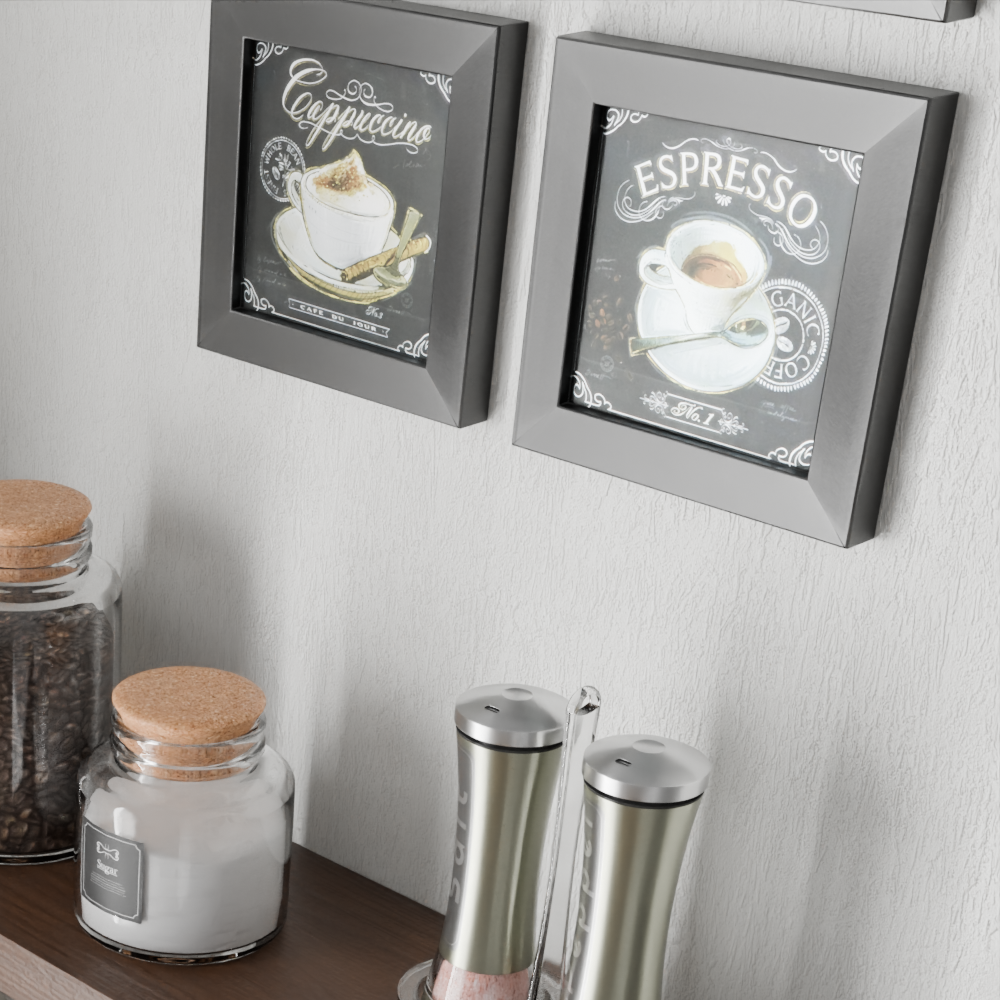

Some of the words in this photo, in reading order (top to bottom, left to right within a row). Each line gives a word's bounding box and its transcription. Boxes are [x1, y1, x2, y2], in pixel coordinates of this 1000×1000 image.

[281, 58, 432, 152] Cappuccino
[263, 142, 283, 164] WHOLE
[286, 144, 301, 166] BEAN
[633, 151, 819, 229] ESPRESSO
[299, 305, 324, 316] CAFE
[331, 313, 345, 322] DU
[771, 290, 820, 337] GANIC
[764, 355, 811, 379] COFF
[96, 858, 119, 877] Sugar
